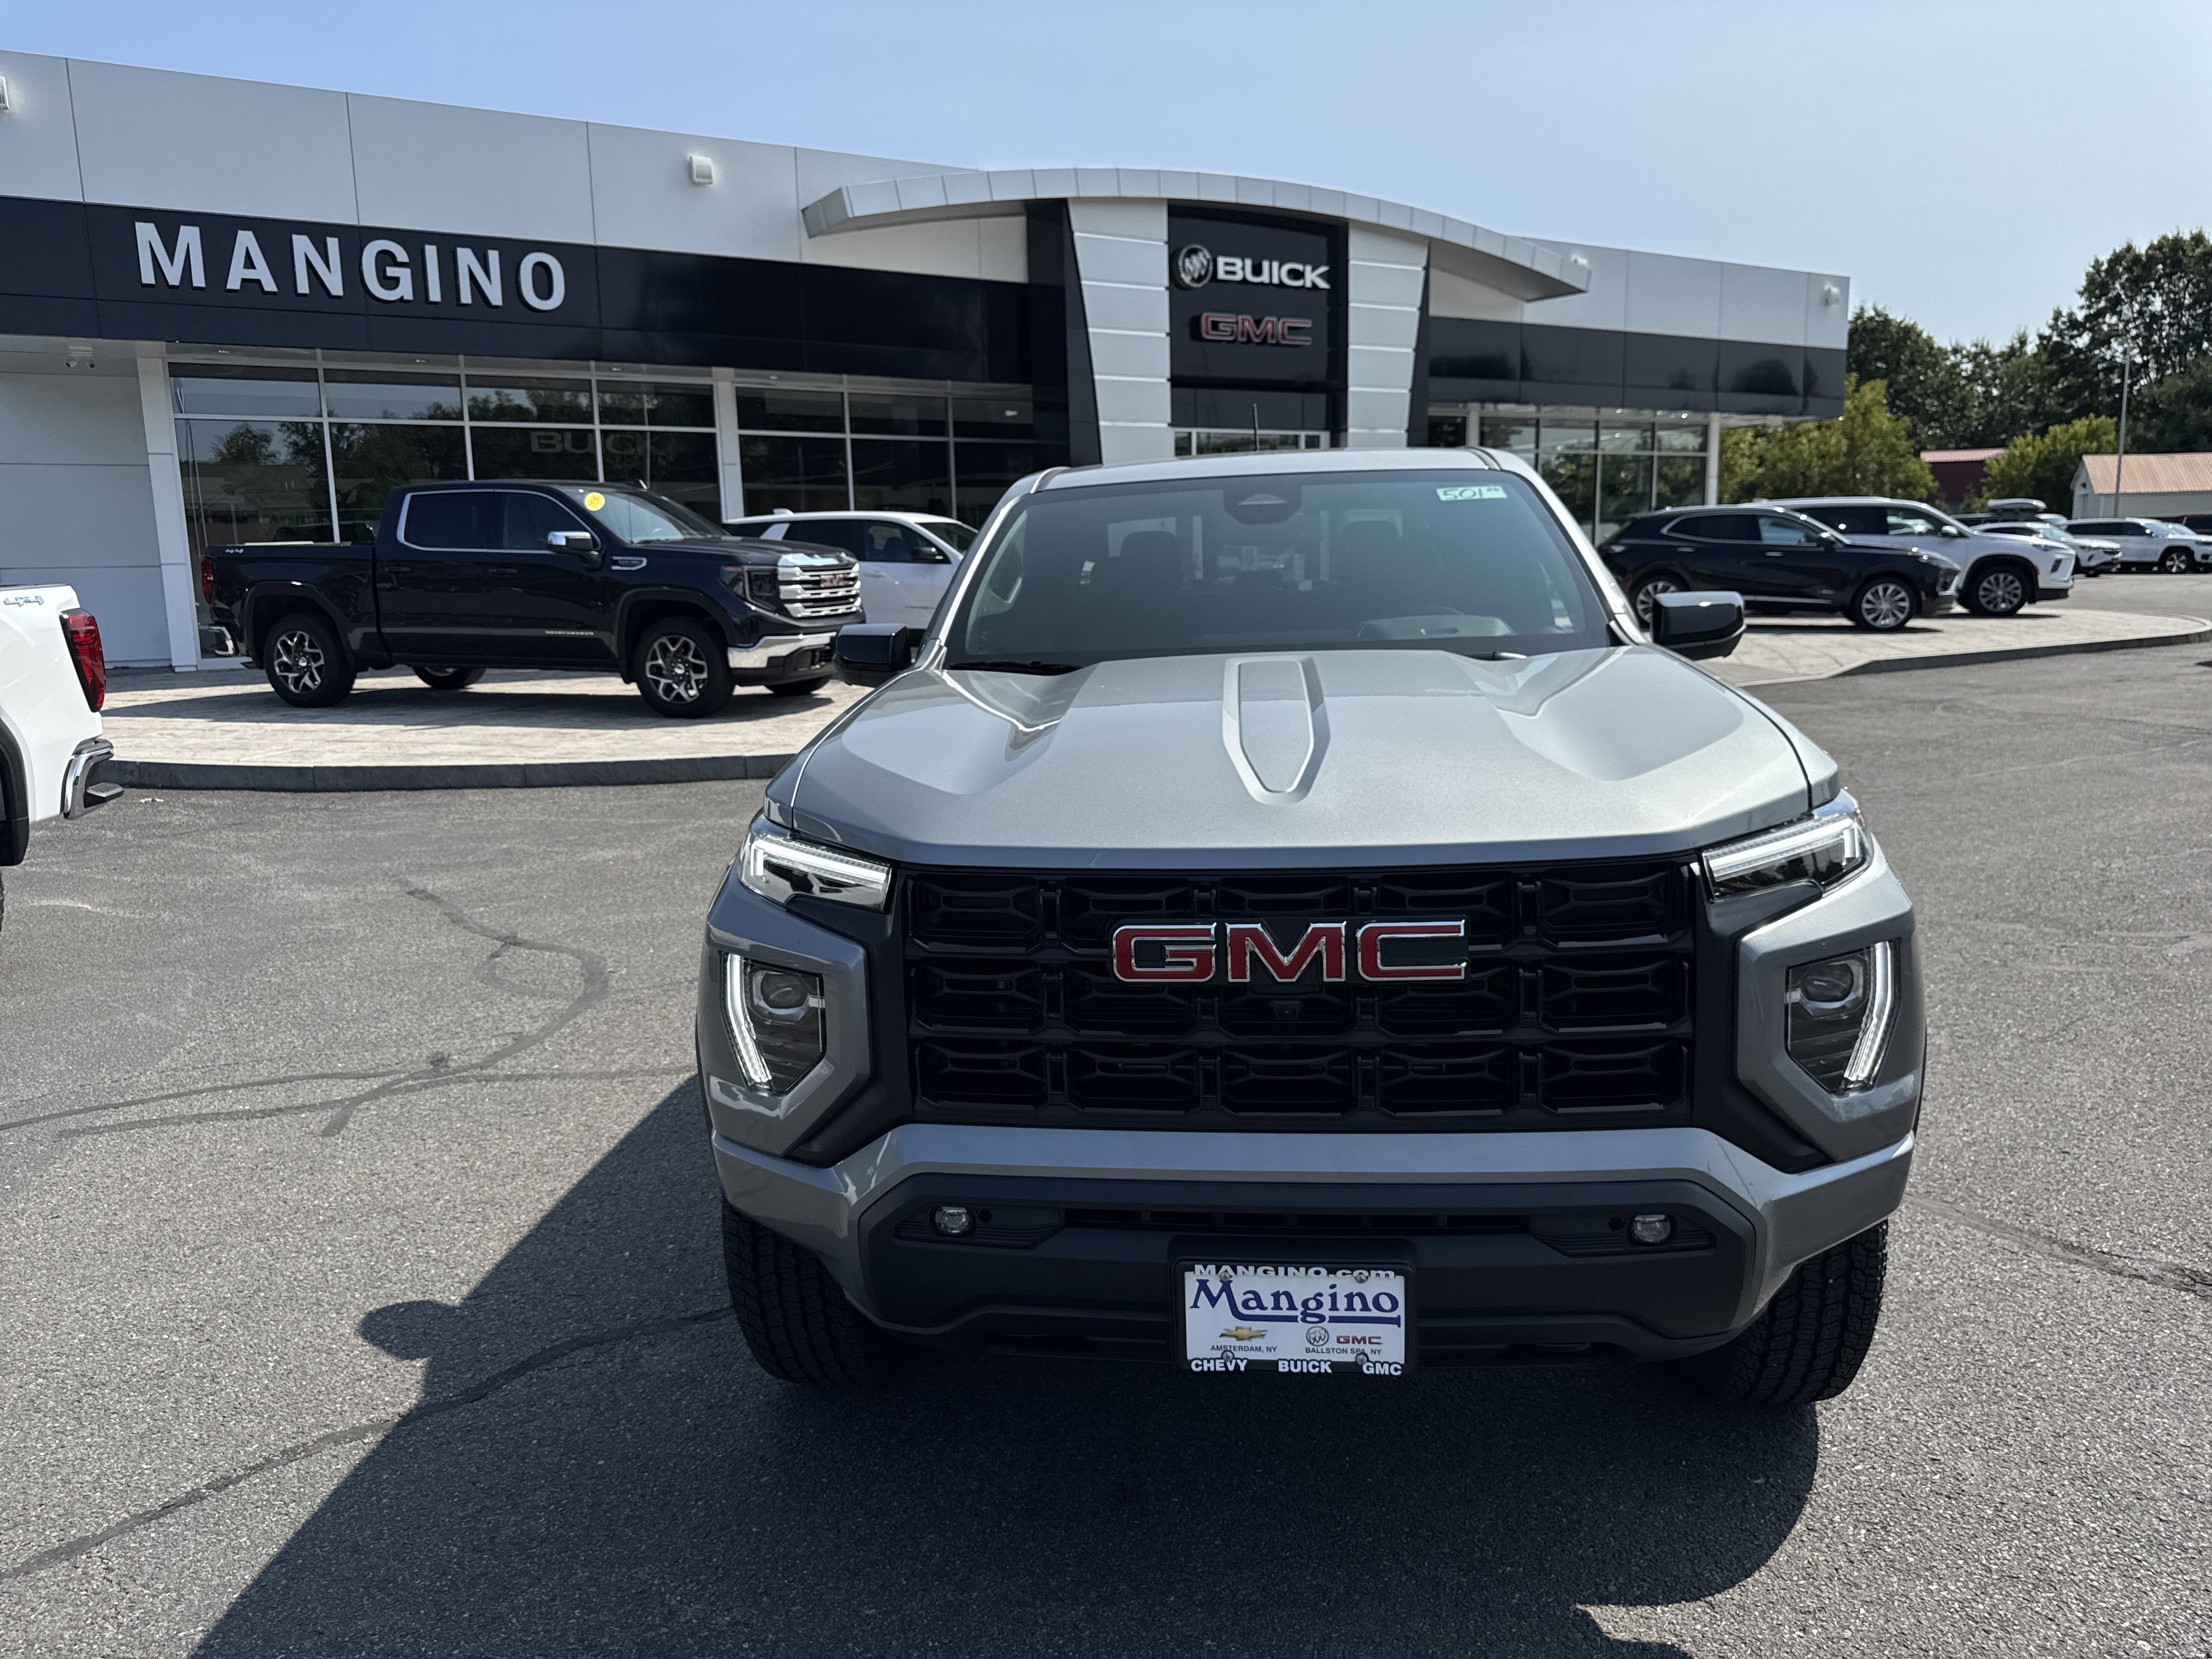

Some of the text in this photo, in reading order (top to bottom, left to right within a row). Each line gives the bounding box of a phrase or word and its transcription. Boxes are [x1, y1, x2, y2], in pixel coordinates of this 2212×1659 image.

[135, 222, 565, 311] MANGINO
[1216, 255, 1331, 289] BUICK
[1201, 311, 1312, 346] GMC
[1113, 920, 1467, 983] GMC
[1189, 1279, 1401, 1328] Mangino
[1210, 1345, 1264, 1353] AMSTERDAM,
[1336, 1335, 1383, 1345] GMC
[1190, 1358, 1402, 1376] CHEVY BUICK GMC
